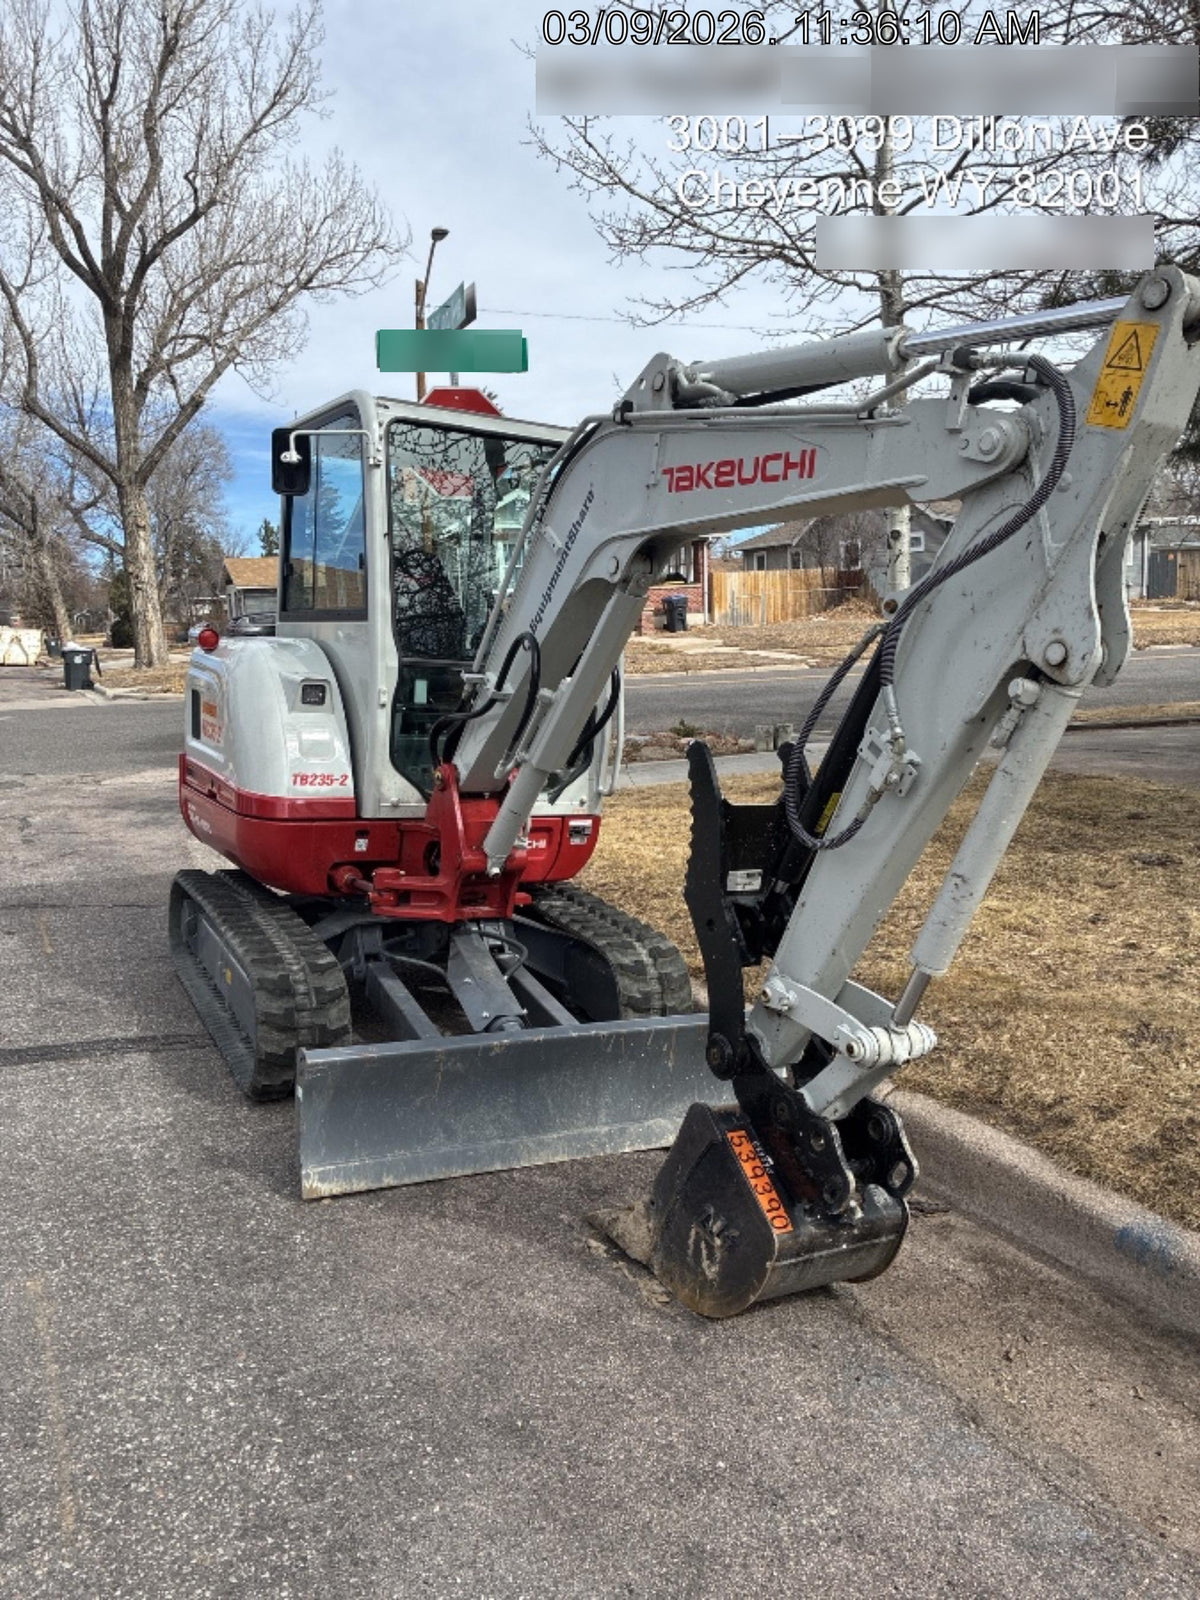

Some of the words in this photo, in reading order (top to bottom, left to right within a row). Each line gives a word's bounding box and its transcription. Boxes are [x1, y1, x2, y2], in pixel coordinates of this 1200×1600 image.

[662, 448, 817, 493] TAKEUCHI
[529, 489, 595, 634] EquipmentShare
[291, 773, 349, 787] TB235-2
[730, 1133, 789, 1230] 539390
